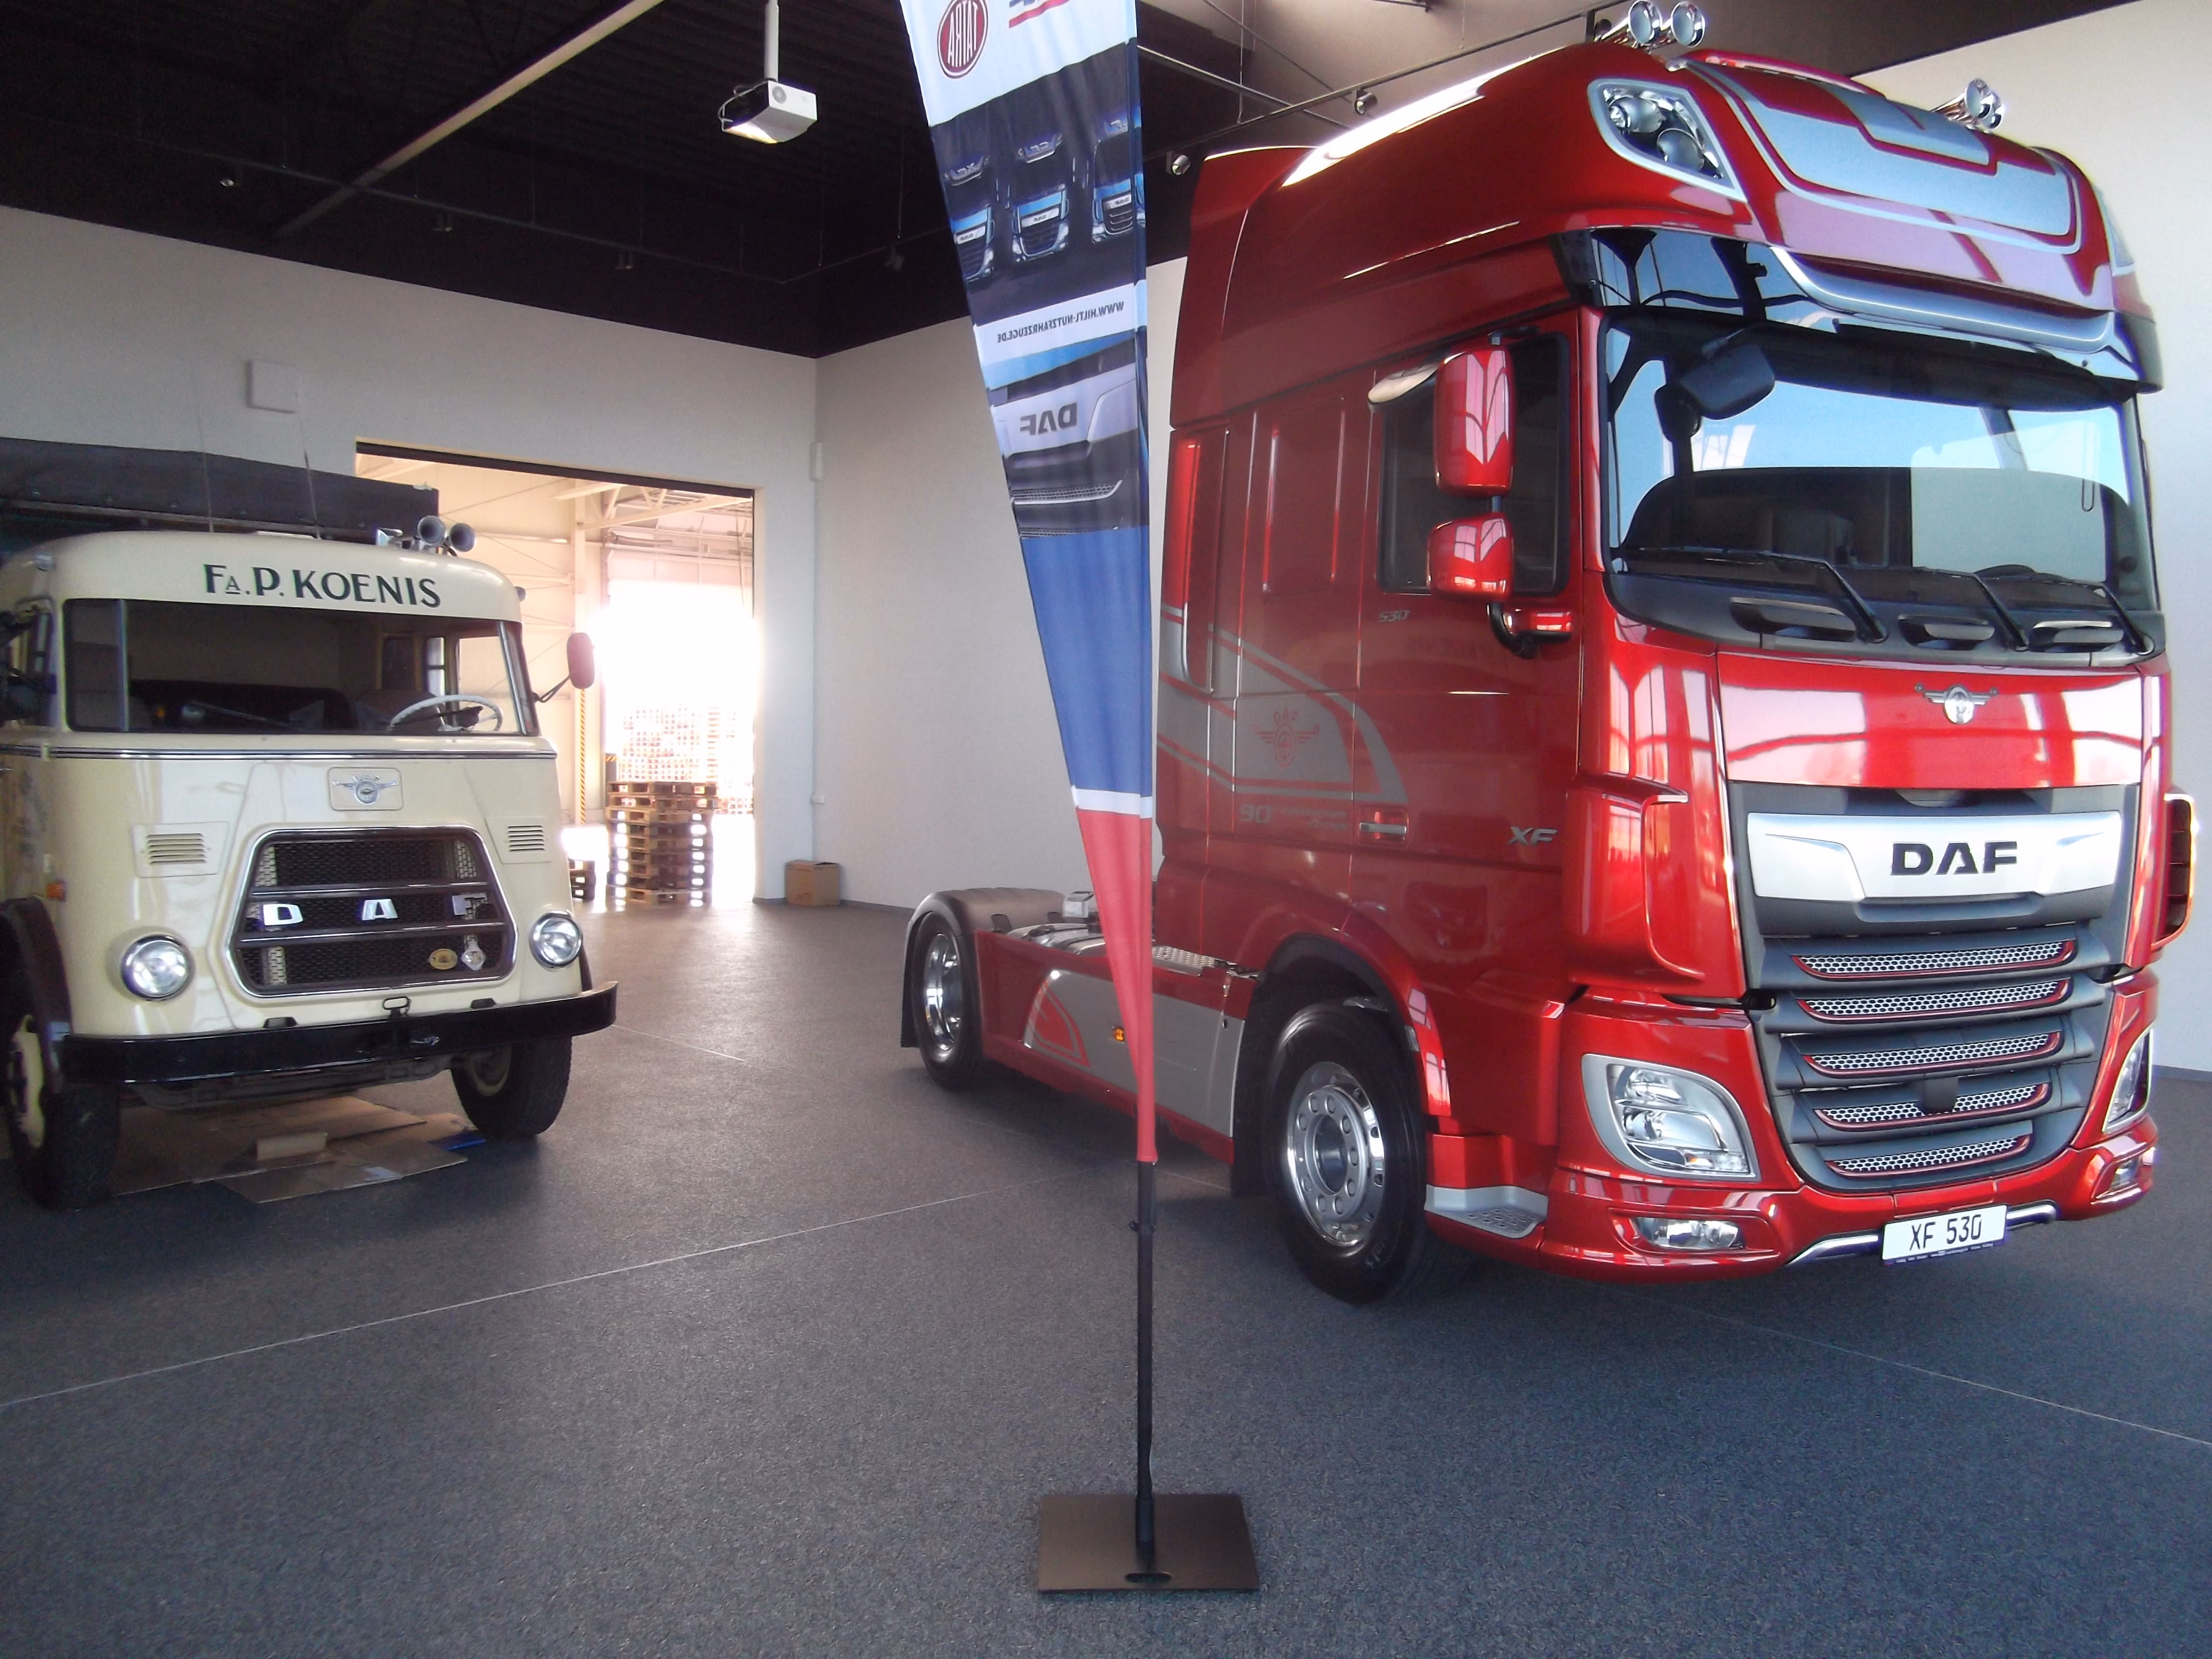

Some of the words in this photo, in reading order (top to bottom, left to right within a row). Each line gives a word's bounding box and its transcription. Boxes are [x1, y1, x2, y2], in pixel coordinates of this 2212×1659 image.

[292, 568, 441, 608] KOENIS
[1378, 609, 1409, 623] 530
[1240, 803, 1272, 824] 90
[1507, 826, 1558, 847] XF
[1891, 840, 2018, 876] DAF
[1910, 1222, 1935, 1251] XF
[1946, 1214, 1982, 1245] 530
